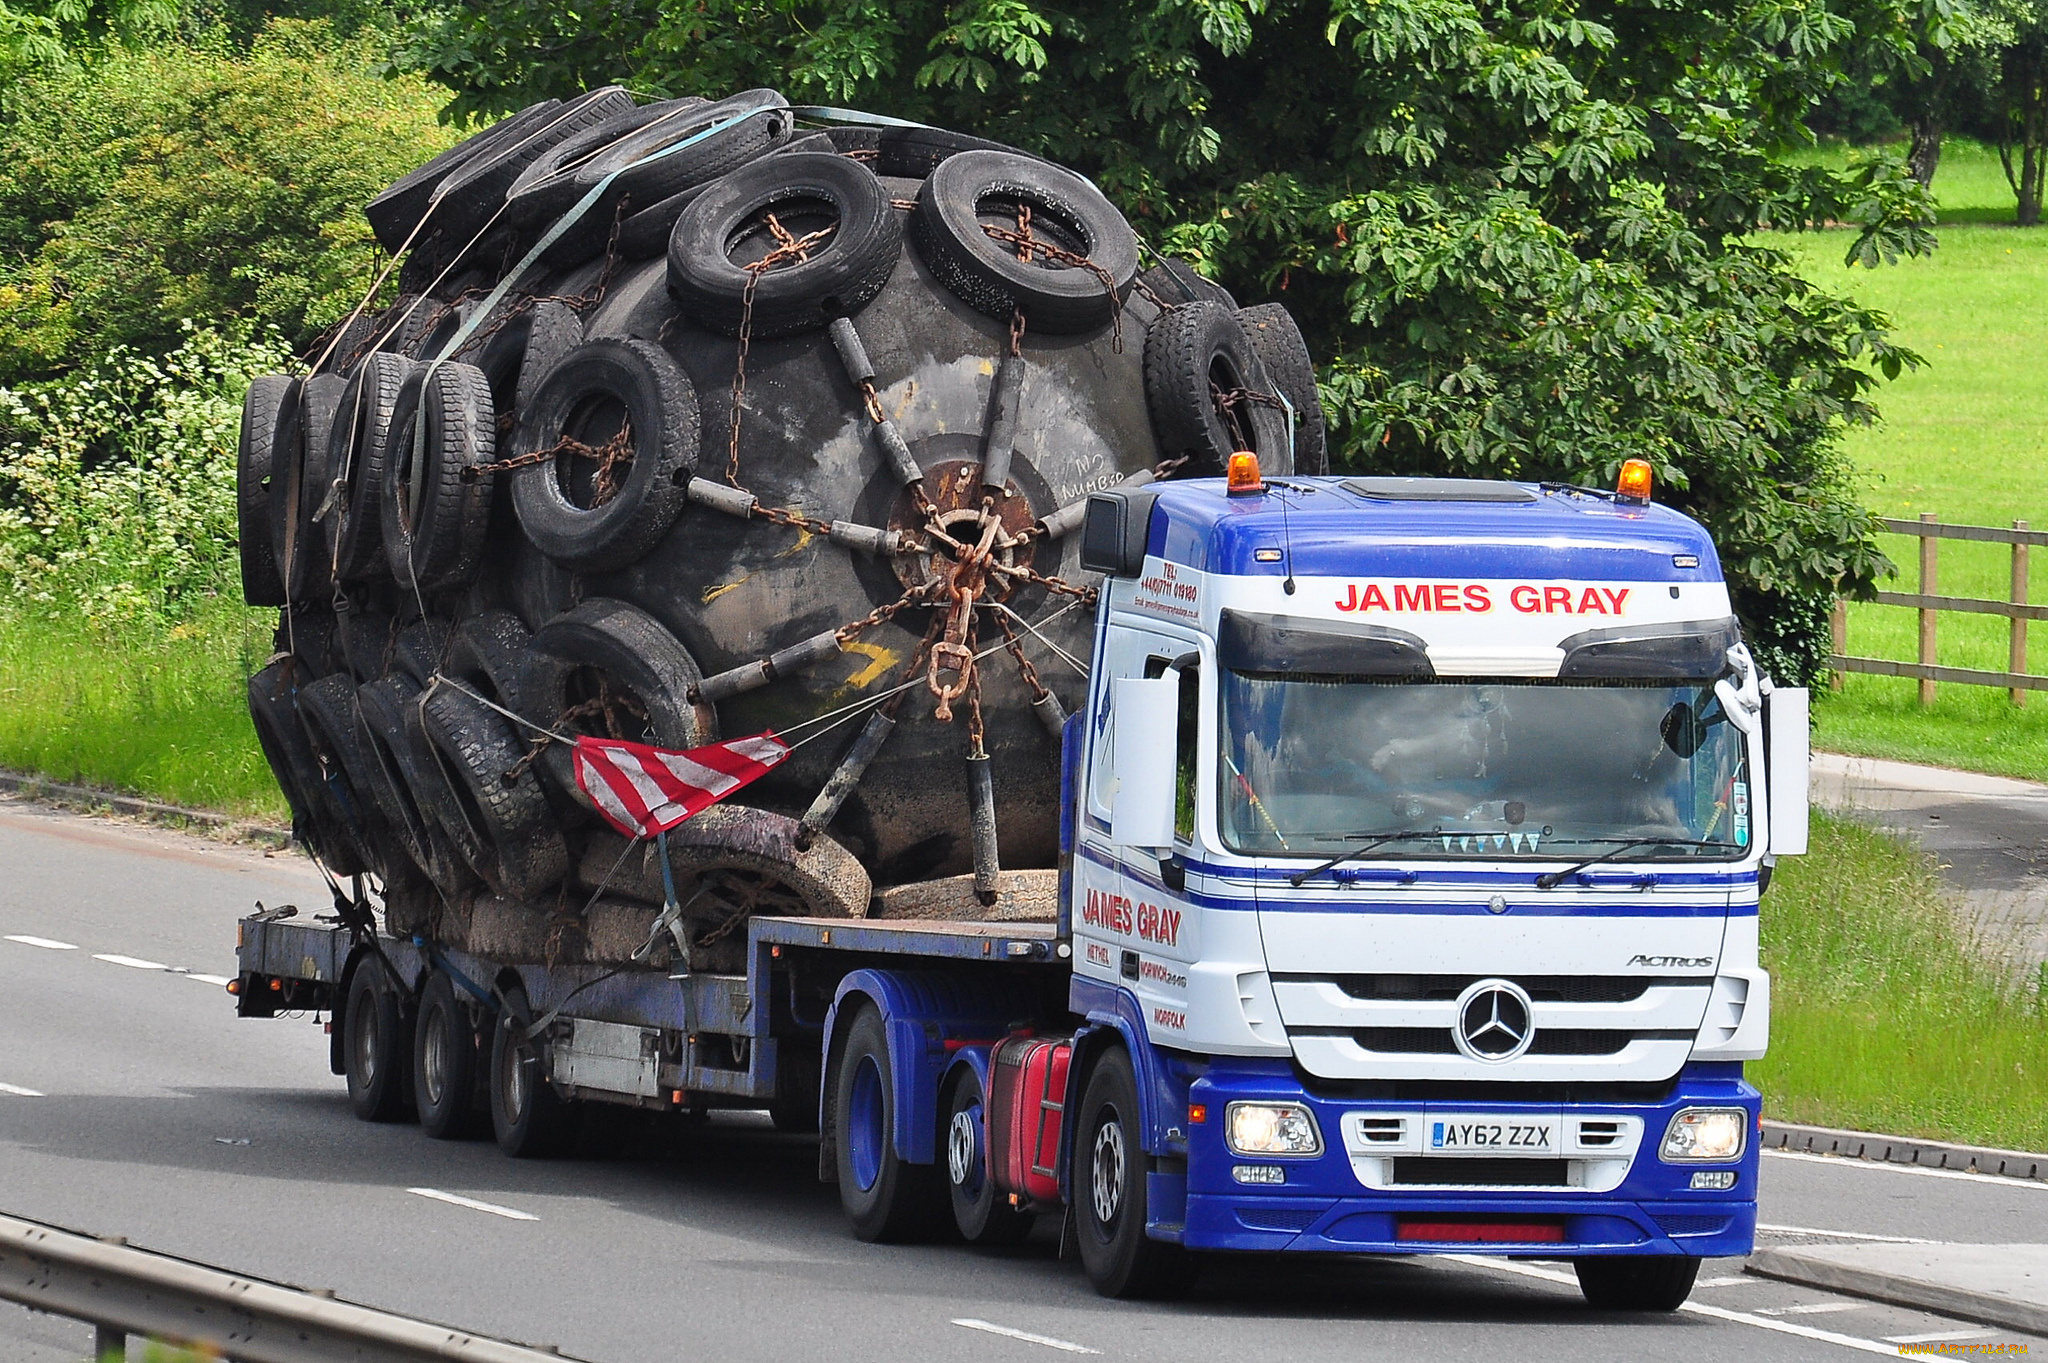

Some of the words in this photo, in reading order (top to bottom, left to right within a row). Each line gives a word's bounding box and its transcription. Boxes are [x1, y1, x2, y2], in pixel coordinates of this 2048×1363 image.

[1335, 584, 1494, 613] JAMES
[1510, 586, 1631, 616] GRAY
[1083, 888, 1133, 936] JAMES
[1137, 902, 1181, 947] GRAY
[1087, 943, 1110, 965] HETHEL
[1140, 960, 1168, 983] NORWICH
[1154, 1007, 1186, 1031] NORFOLK
[1445, 1124, 1502, 1146] AY62
[1508, 1125, 1550, 1147] ZZX
